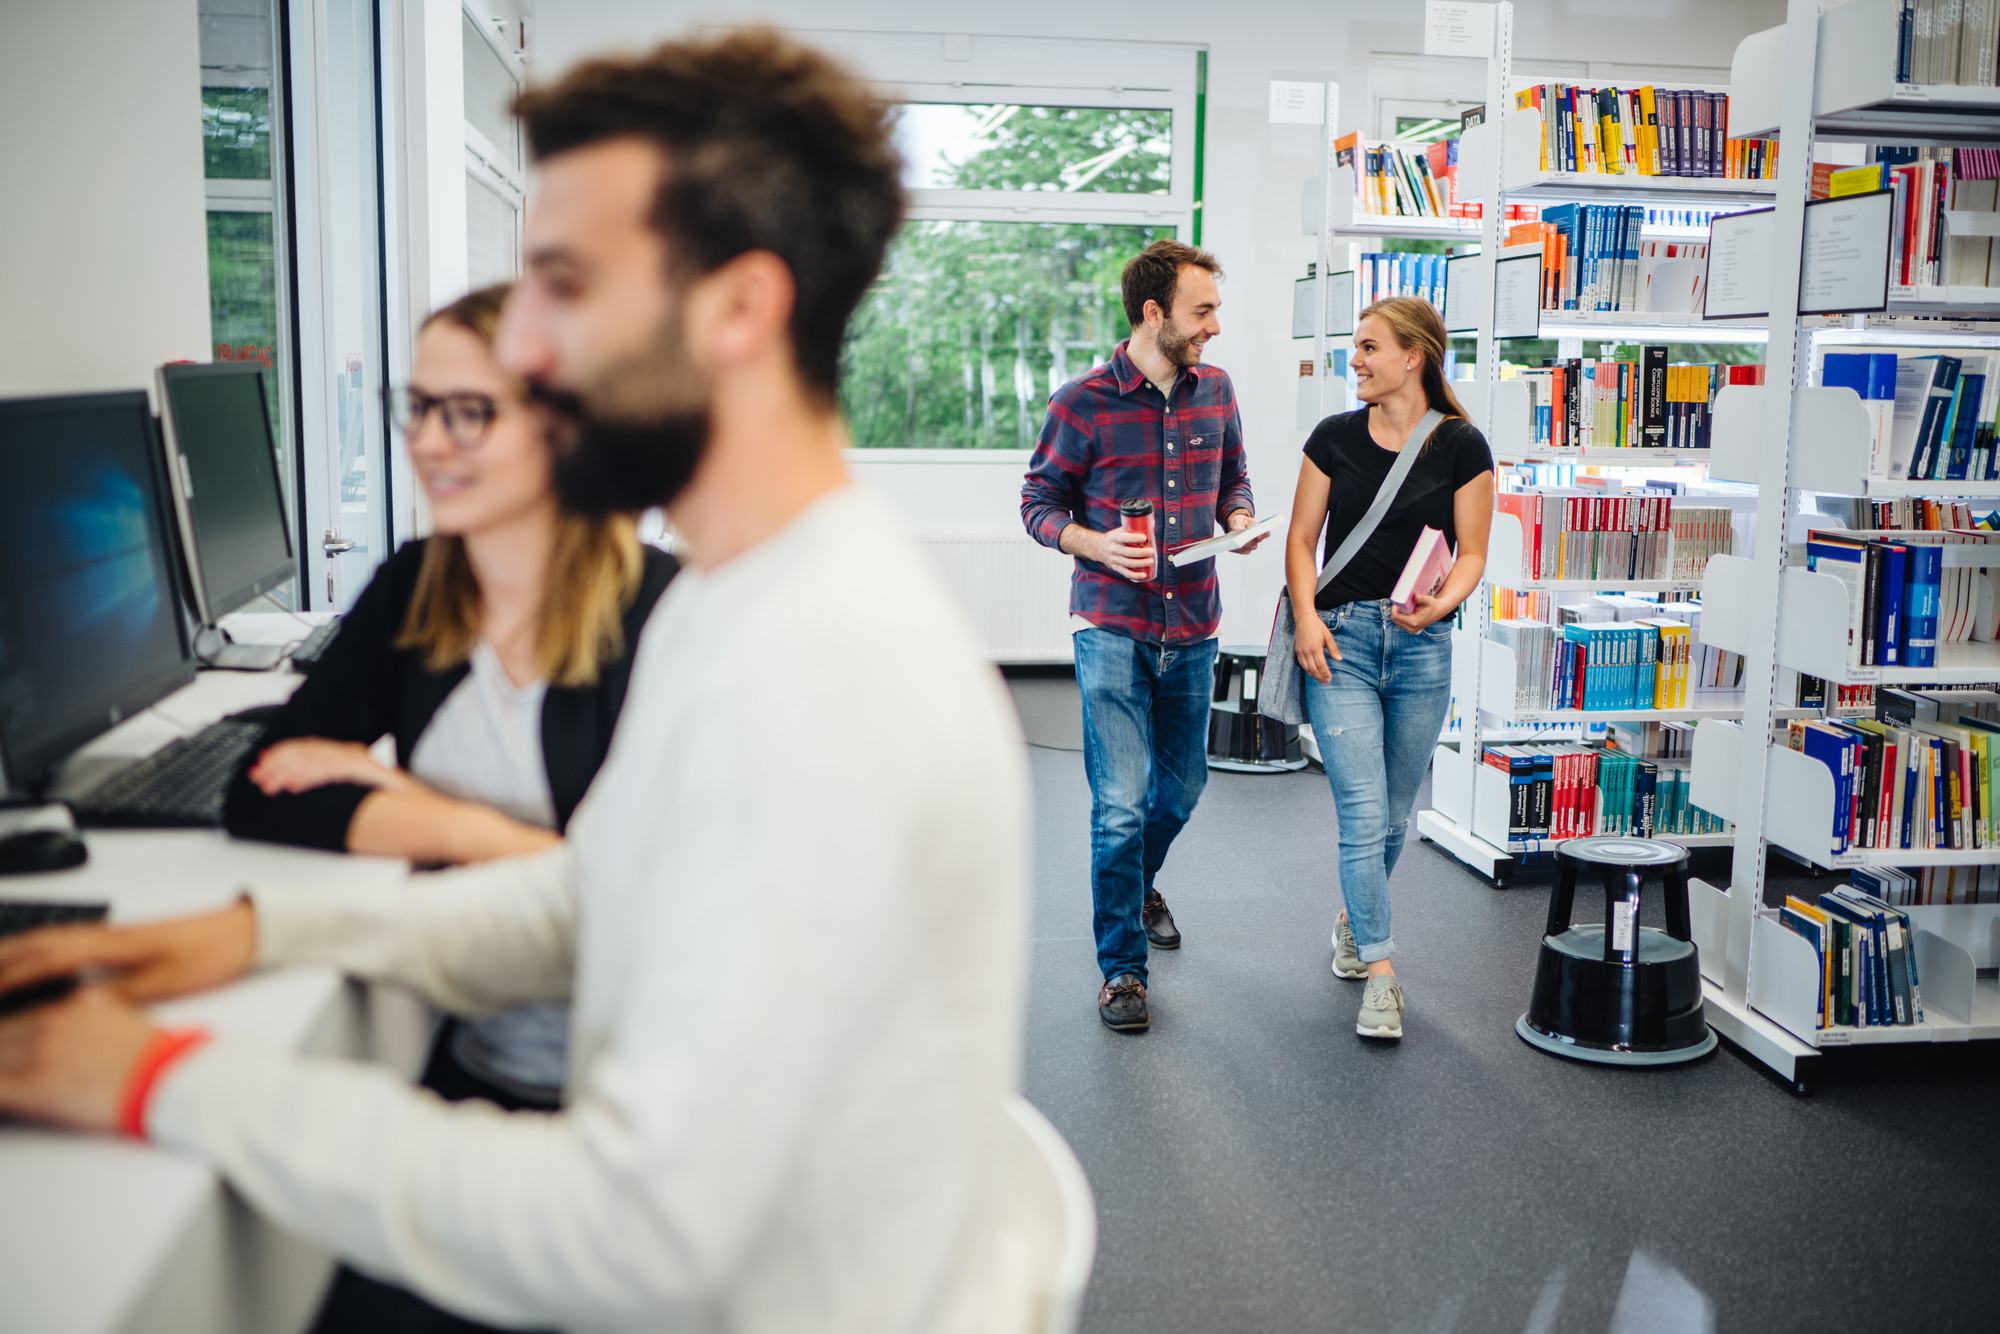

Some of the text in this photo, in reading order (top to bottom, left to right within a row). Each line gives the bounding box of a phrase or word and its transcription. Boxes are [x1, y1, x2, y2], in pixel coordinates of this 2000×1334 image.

[1465, 114, 1481, 129] DATA
[1655, 368, 1664, 417] ENCYCLOPEDIA OF
[1884, 711, 1912, 730] Engineerin
[1640, 792, 1650, 830] Informatik-
